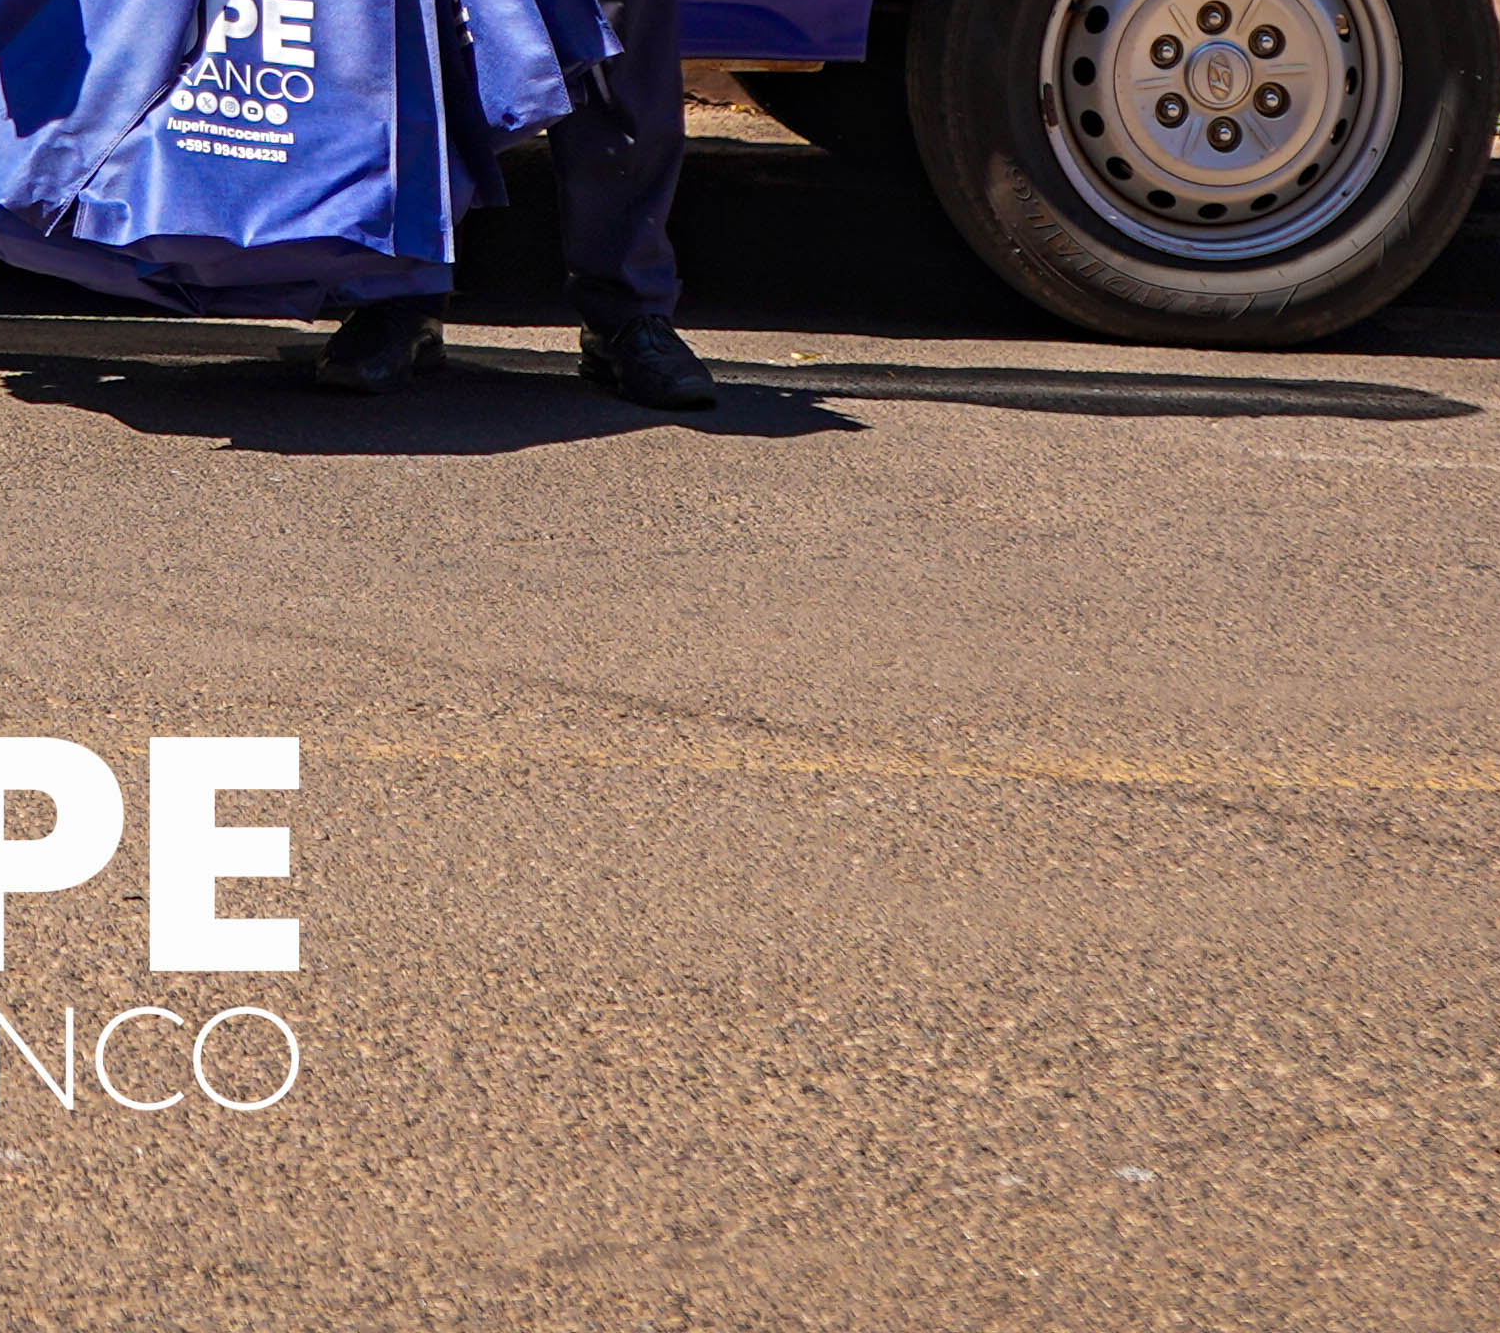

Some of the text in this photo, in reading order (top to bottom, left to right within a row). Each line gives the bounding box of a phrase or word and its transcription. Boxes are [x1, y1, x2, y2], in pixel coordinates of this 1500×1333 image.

[166, 116, 295, 145] /upefrancocentral
[176, 138, 288, 164] +595 994364238
